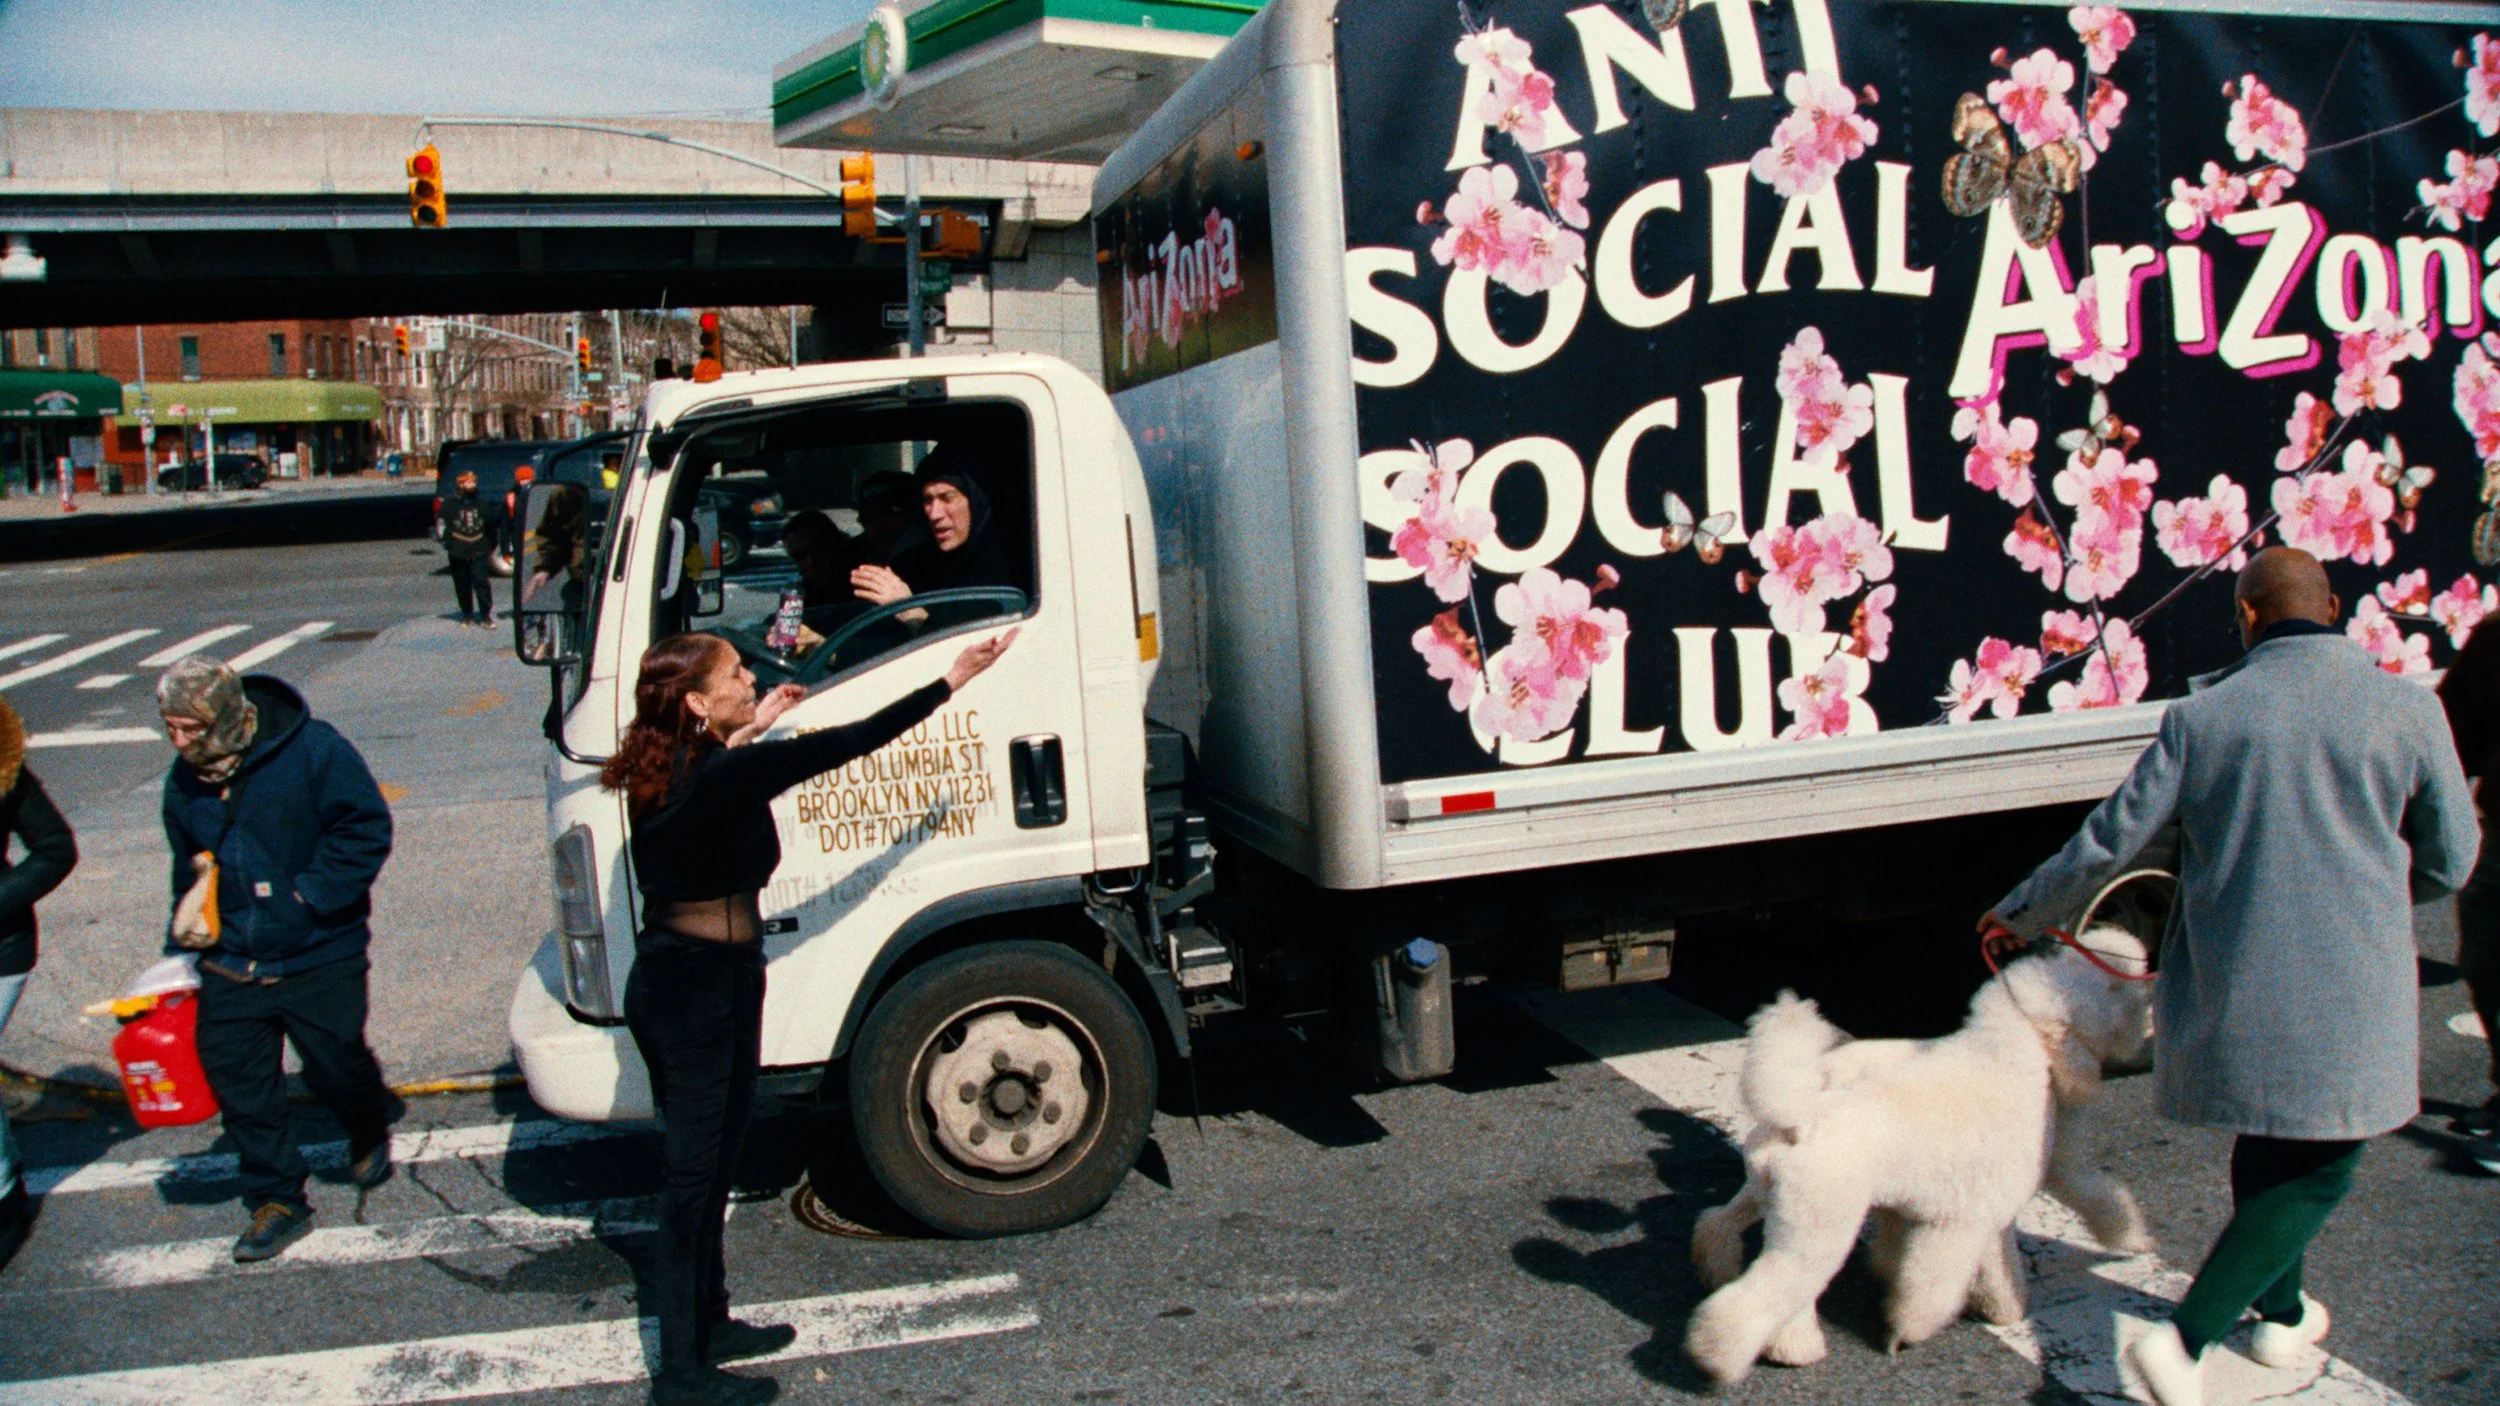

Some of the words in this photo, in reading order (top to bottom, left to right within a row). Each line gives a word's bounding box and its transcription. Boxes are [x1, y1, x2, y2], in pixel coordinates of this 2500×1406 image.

[1444, 0, 1842, 171] ANTI
[1121, 215, 1242, 375] AriZona
[1345, 159, 1935, 388] SOCIAL
[1358, 373, 1950, 582] SOCIAL
[846, 745, 956, 786] COLUMBIA
[959, 742, 985, 773] ST
[943, 709, 981, 742] LLC
[1469, 626, 1879, 765] CLUB
[797, 781, 910, 823] BROOKLYN
[914, 778, 943, 810] NY
[947, 771, 994, 806] 11231
[819, 807, 977, 853] DOT#707794NY
